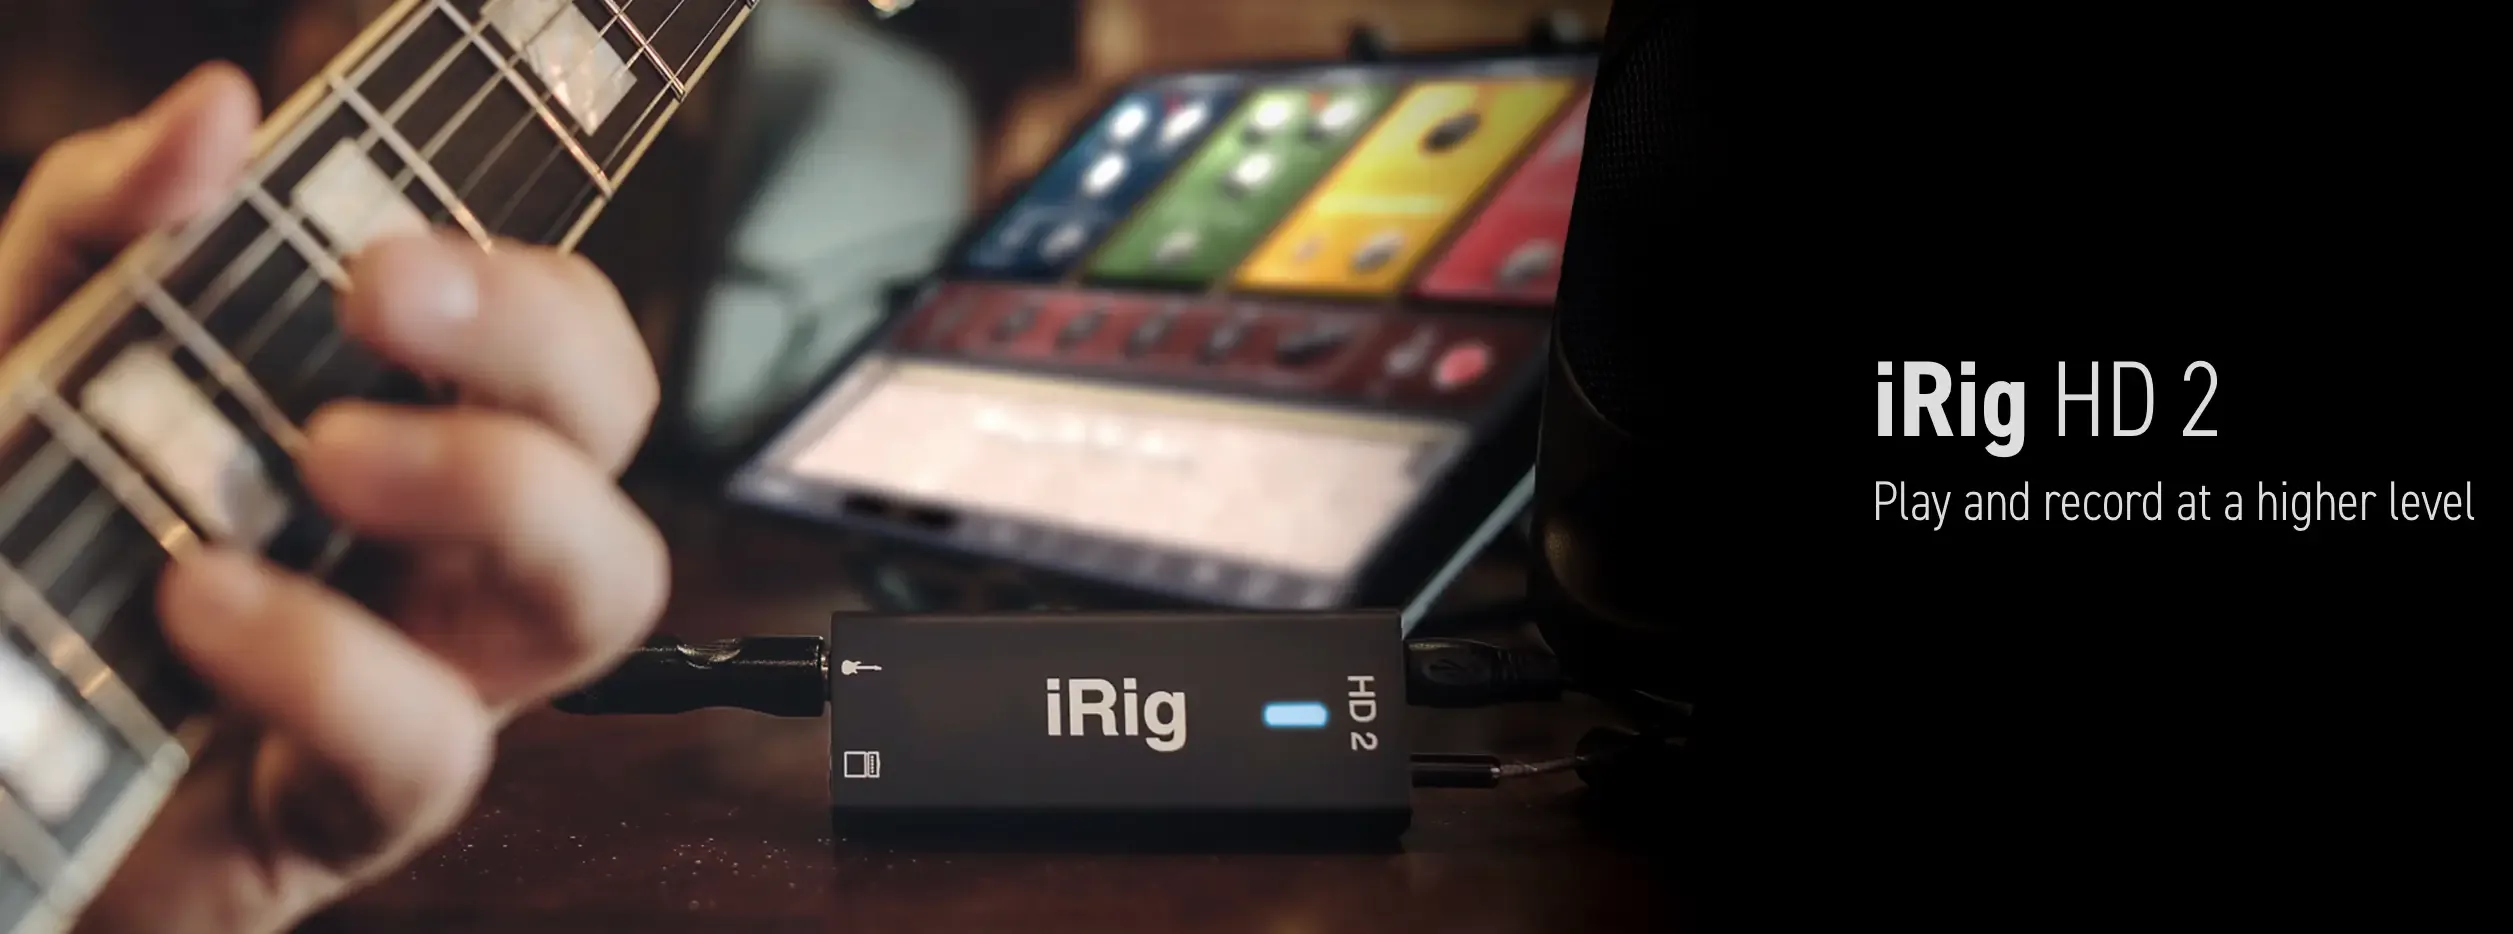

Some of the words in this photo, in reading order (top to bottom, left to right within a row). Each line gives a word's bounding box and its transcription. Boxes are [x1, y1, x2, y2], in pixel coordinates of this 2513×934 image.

[1046, 677, 1188, 752] iRig
[1347, 675, 1378, 724] HD
[1350, 731, 1379, 752] 2
